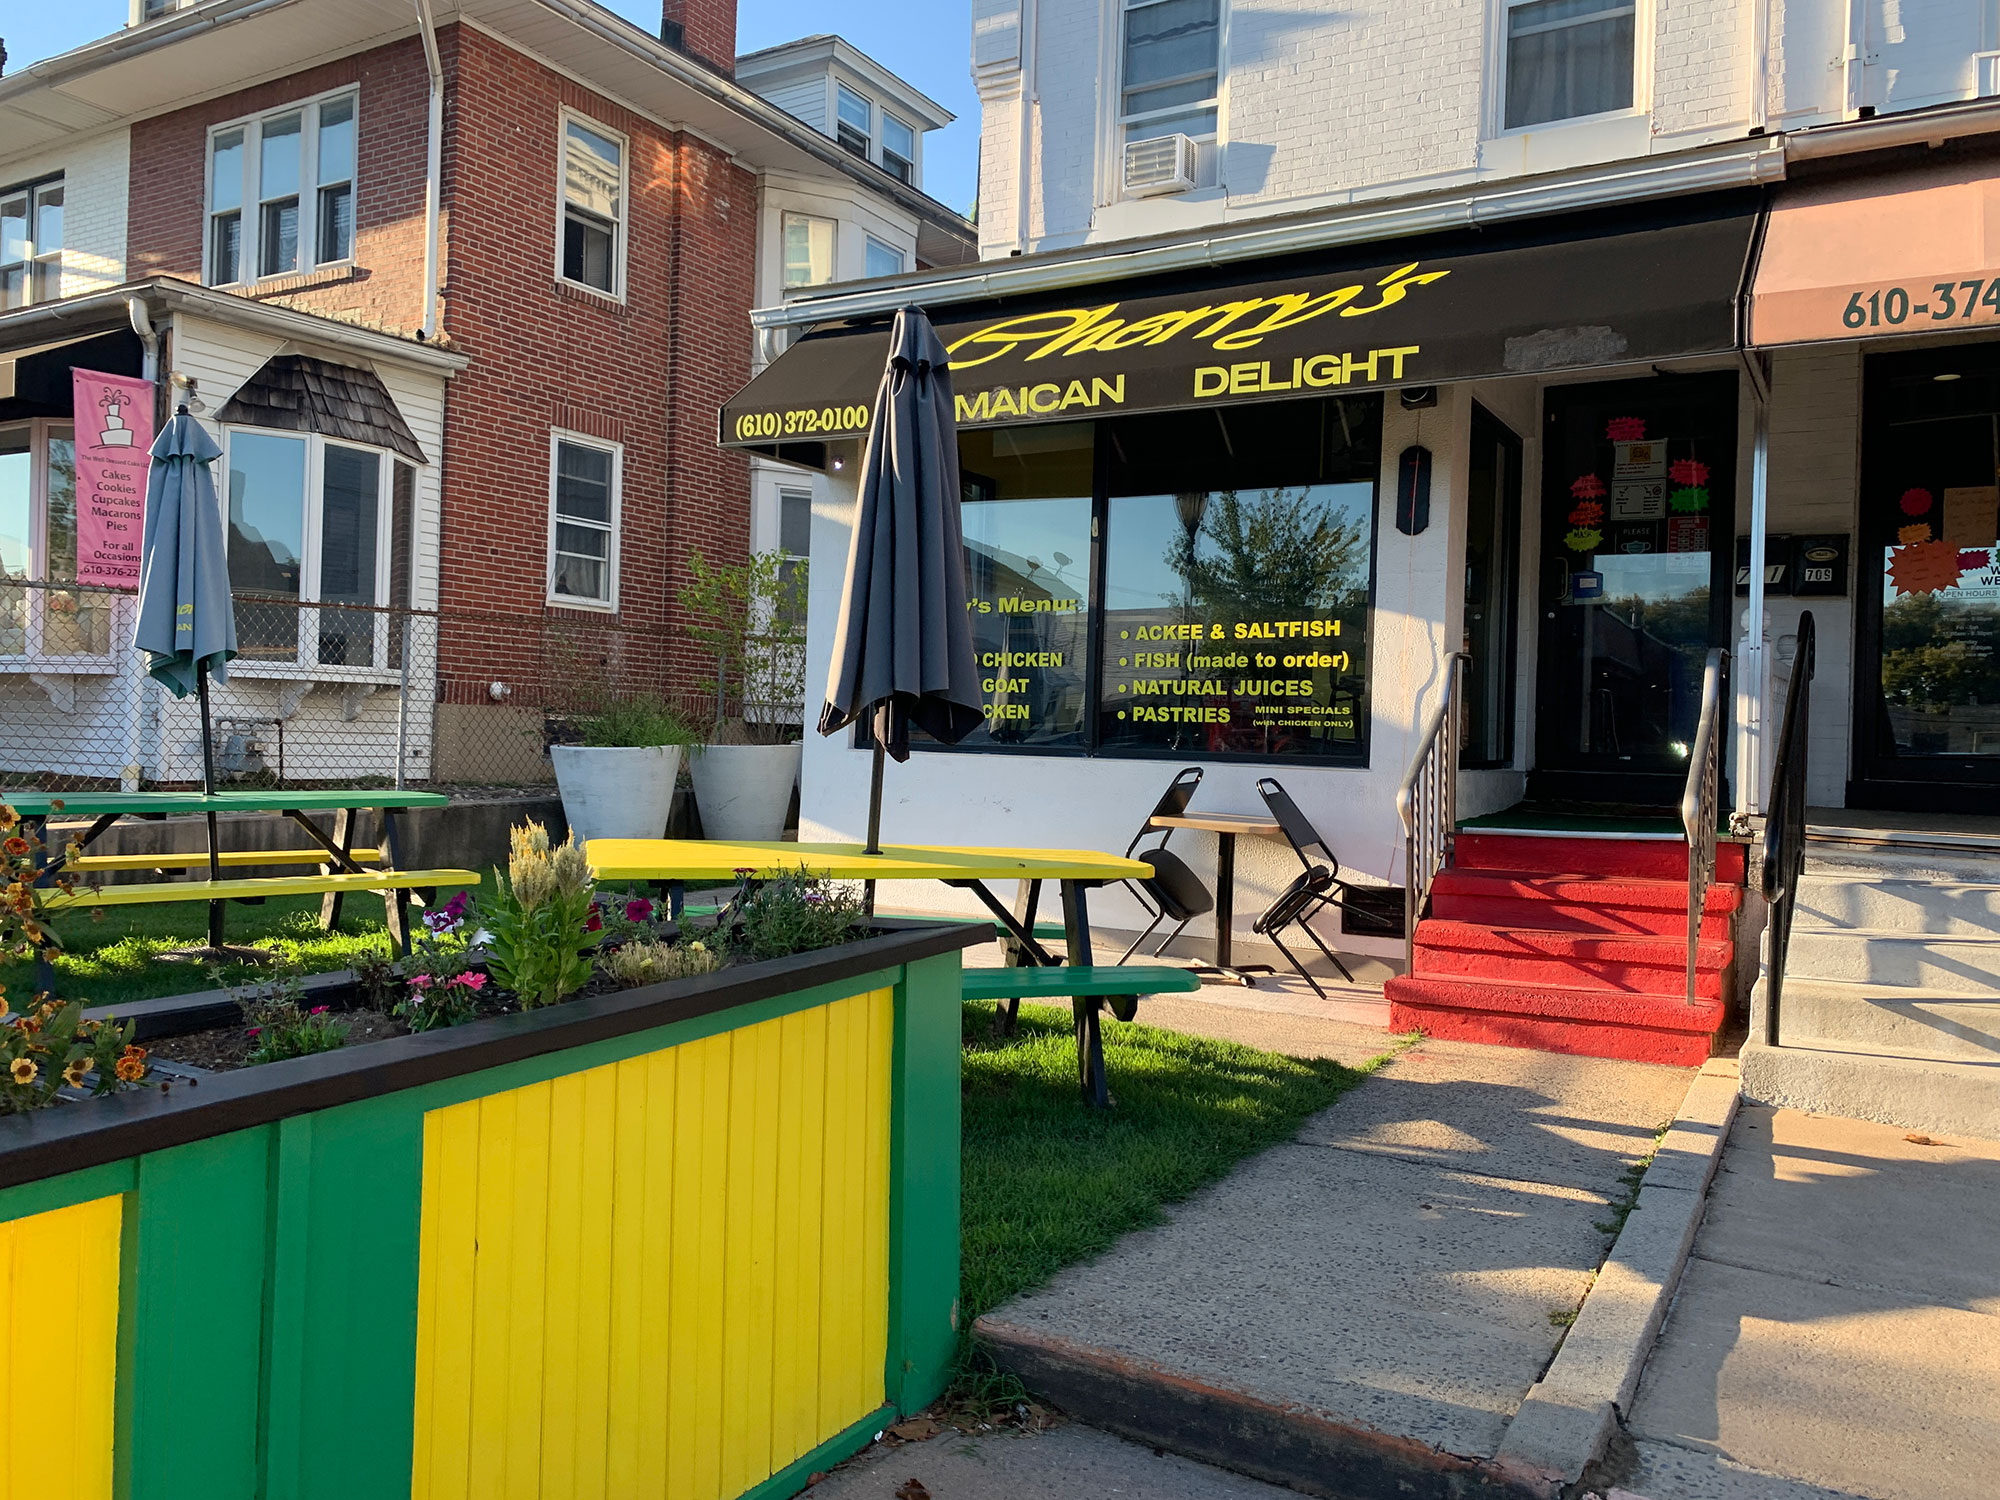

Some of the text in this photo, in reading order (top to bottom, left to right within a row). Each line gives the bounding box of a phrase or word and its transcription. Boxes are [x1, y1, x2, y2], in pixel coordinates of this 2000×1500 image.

[946, 261, 1452, 370] Cherry's
[954, 345, 1420, 422] MAICAN DELIGHT
[736, 405, 869, 441] (610) 372-0100
[101, 469, 131, 481] Cakes
[97, 481, 136, 495] Cookies
[92, 494, 141, 508] Cupcakes
[91, 507, 141, 520] Macarons
[106, 521, 128, 531] Pies
[1623, 527, 1650, 536] PLEASE
[103, 540, 134, 551] For all
[94, 550, 142, 562] Occasions
[83, 565, 140, 577] 610-376-22
[1939, 589, 1997, 599] OPEN HOURS
[998, 597, 1078, 613] Menu:
[1135, 620, 1341, 640] ACKEE & SALTFISH
[982, 652, 1063, 667] CHICKEN
[1134, 650, 1349, 672] FISH (made to order)
[982, 678, 1030, 693] GOAT
[1133, 679, 1314, 696] NATURAL JUICES
[983, 704, 1030, 719] CKEN
[1132, 706, 1231, 723] PASTRIES
[1255, 706, 1351, 715] MINI SPECIALS
[1252, 719, 1276, 728] (with
[1323, 720, 1354, 729] ONLY)
